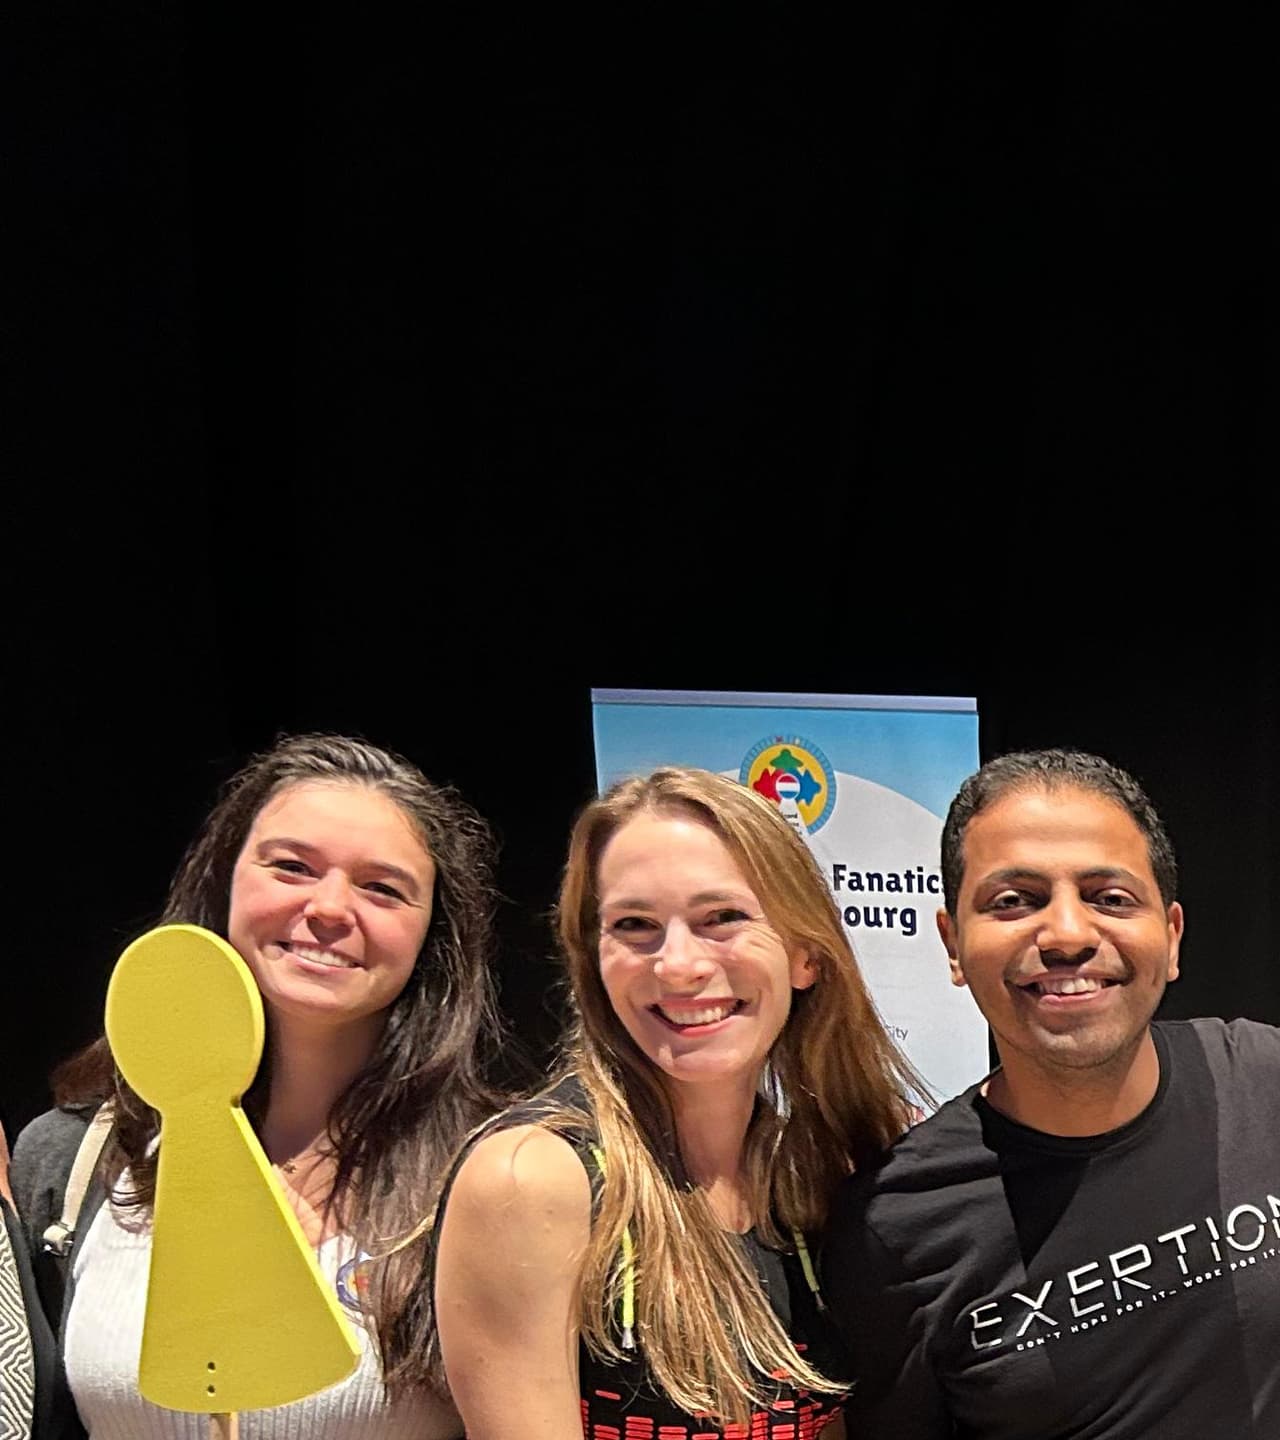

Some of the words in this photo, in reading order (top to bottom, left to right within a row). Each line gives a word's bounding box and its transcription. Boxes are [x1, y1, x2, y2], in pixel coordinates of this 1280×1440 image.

[833, 864, 944, 894] Fanatic
[841, 904, 917, 936] ourg
[1070, 1314, 1108, 1334] HOPE
[1116, 1300, 1143, 1316] FOR
[1183, 1268, 1222, 1288] WORK
[1230, 1256, 1256, 1271] FOR
